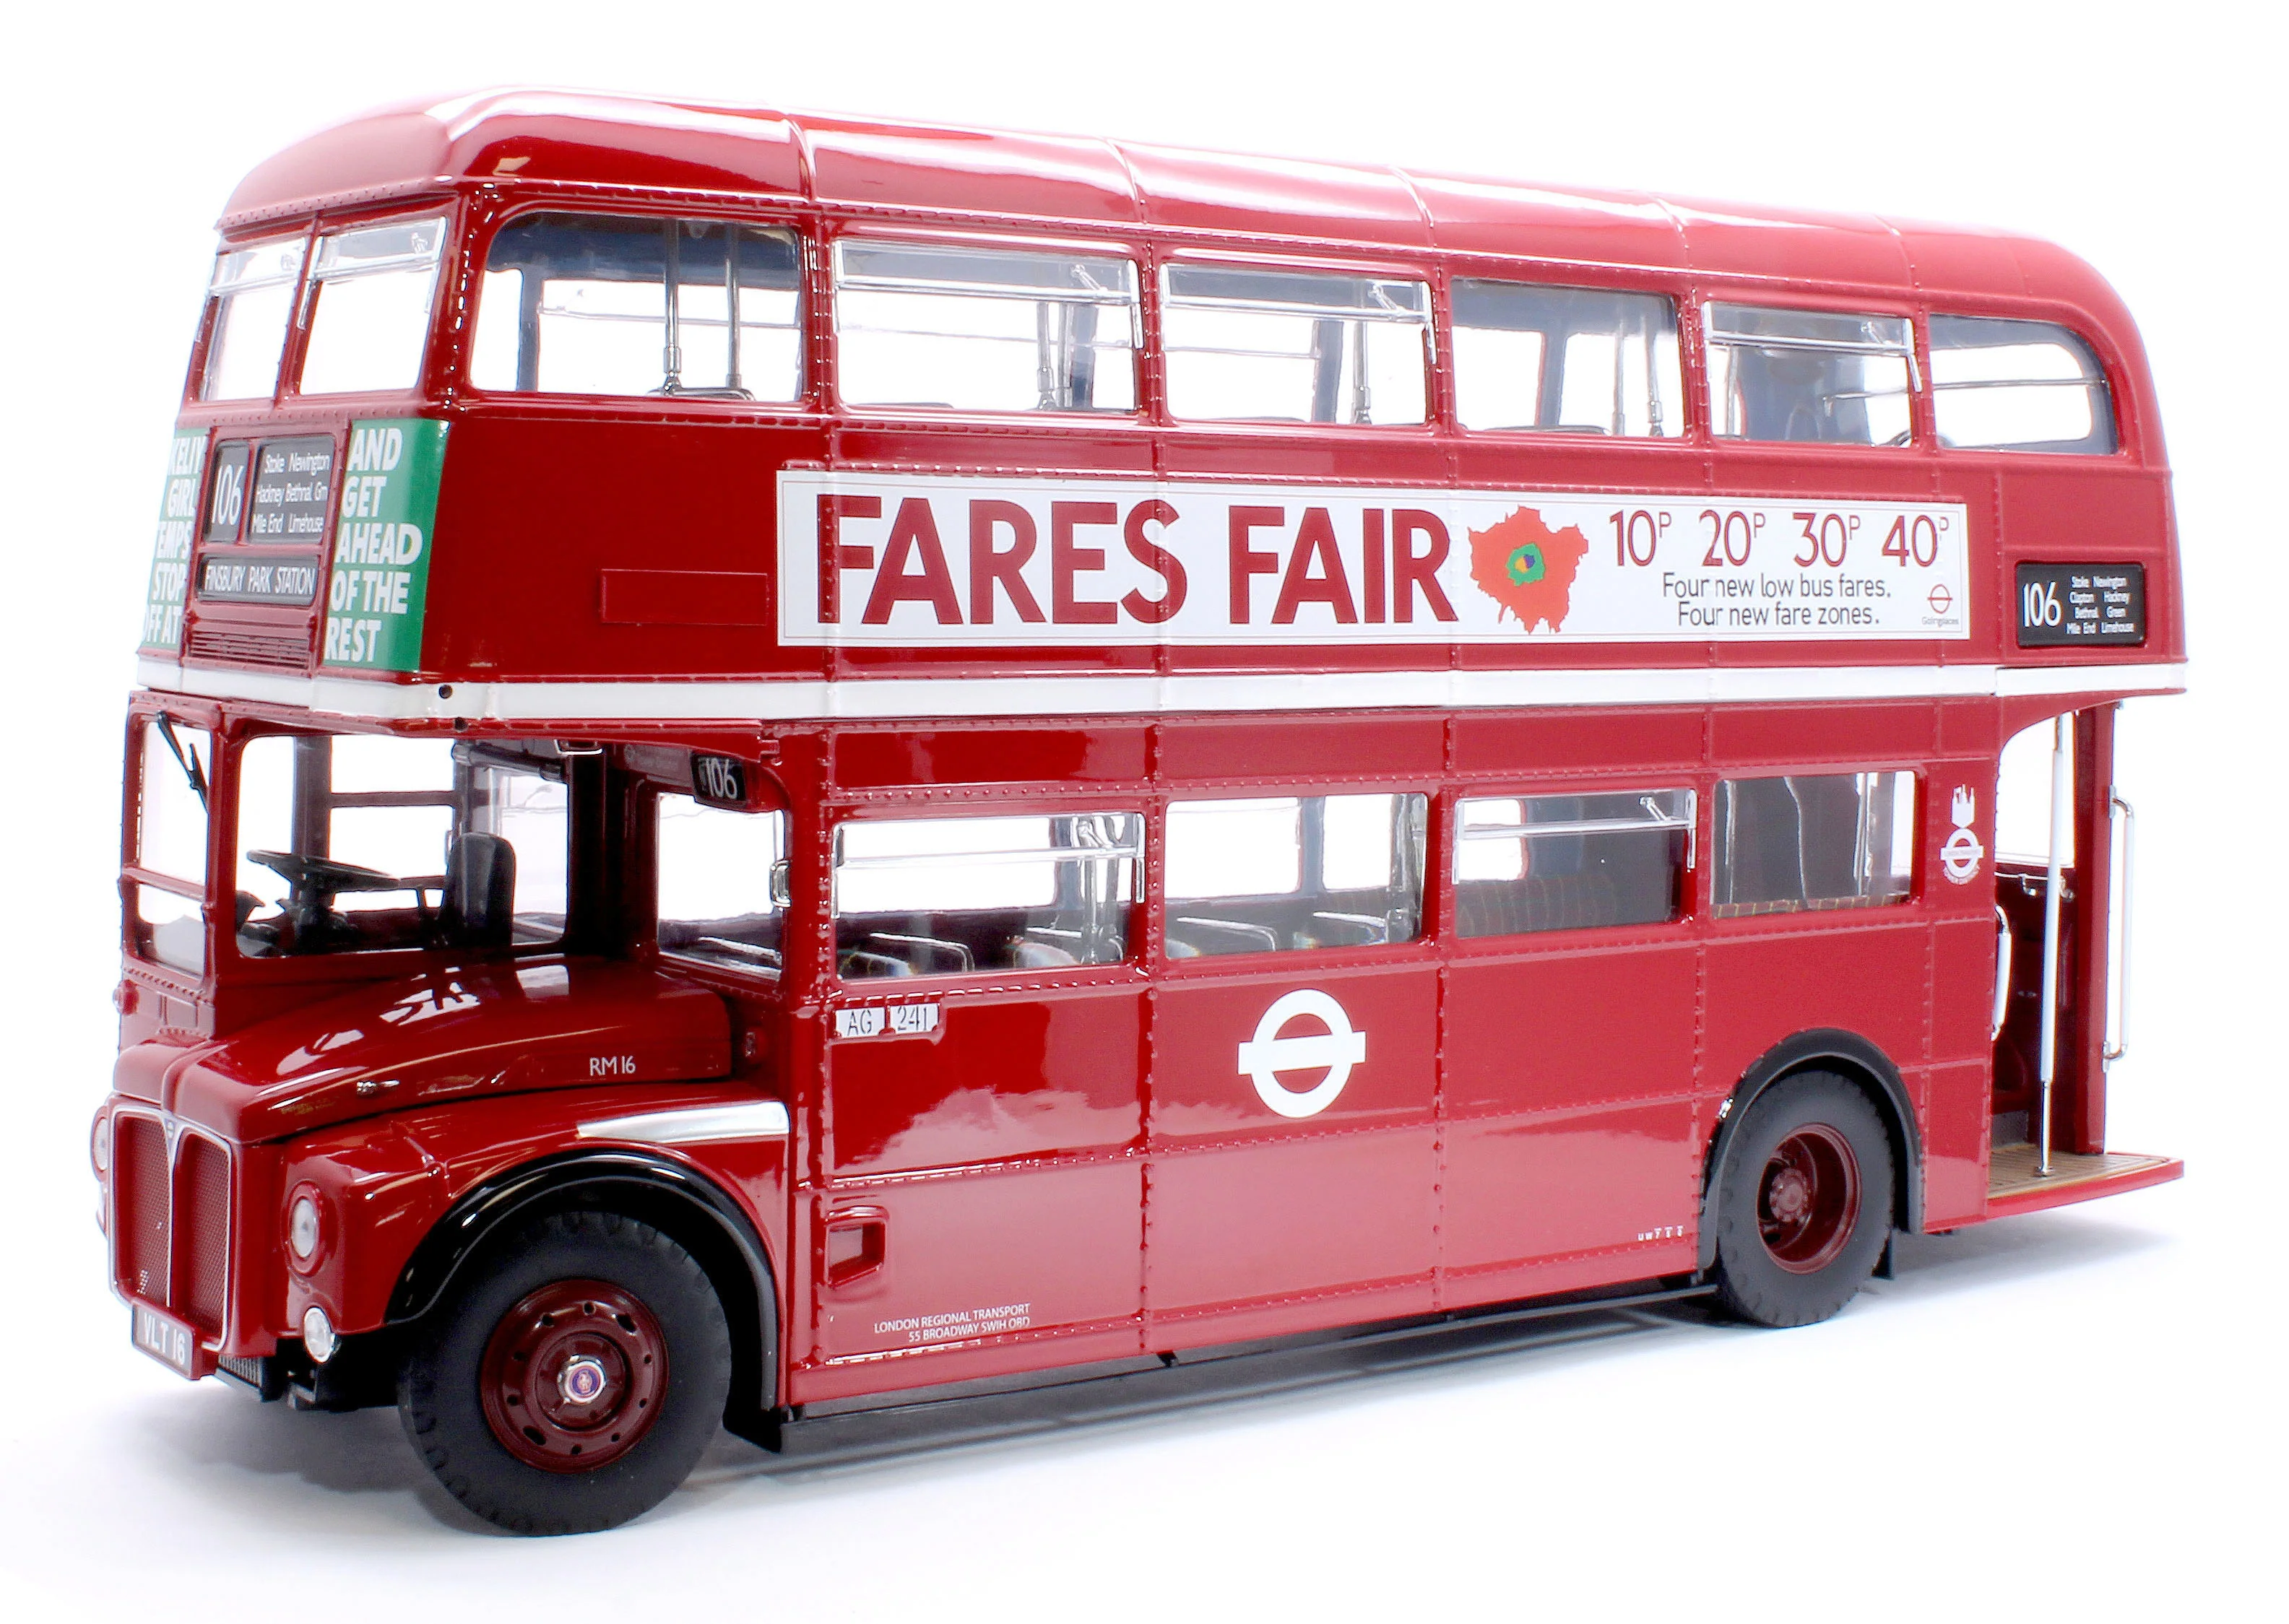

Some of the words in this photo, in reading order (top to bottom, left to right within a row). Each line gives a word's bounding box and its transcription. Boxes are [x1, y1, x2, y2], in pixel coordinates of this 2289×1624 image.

[347, 427, 402, 471] AND
[212, 464, 243, 526] 106
[341, 475, 387, 518] GET
[335, 522, 423, 566] AHEAD
[817, 494, 1187, 624] FARES
[1228, 505, 1459, 625] FAIR
[248, 565, 274, 594] PARK
[274, 566, 316, 596] STATION
[330, 570, 360, 612] OF
[363, 570, 411, 615] THE
[1663, 572, 1710, 599] Four
[1715, 579, 1755, 598] new
[1760, 573, 1794, 599] low
[1800, 573, 1834, 598] bus
[1838, 573, 1892, 598] fares.
[1678, 601, 1723, 626] Four
[1729, 607, 1769, 626] new
[1775, 601, 1812, 626] fare
[1817, 607, 1879, 626] zones.
[2022, 581, 2062, 628] 106
[324, 617, 382, 662] REST
[706, 757, 737, 799] 106
[847, 1009, 873, 1037] AG
[896, 1004, 928, 1032] 241
[589, 1055, 618, 1077] RM
[620, 1054, 636, 1074] 16
[144, 1312, 169, 1354] VLT
[874, 1316, 920, 1334] LONDON
[921, 1311, 971, 1329] REGIONAL
[972, 1303, 1031, 1321] TRANSPORT
[908, 1331, 921, 1343] 55
[923, 1323, 980, 1341] BROADWAY
